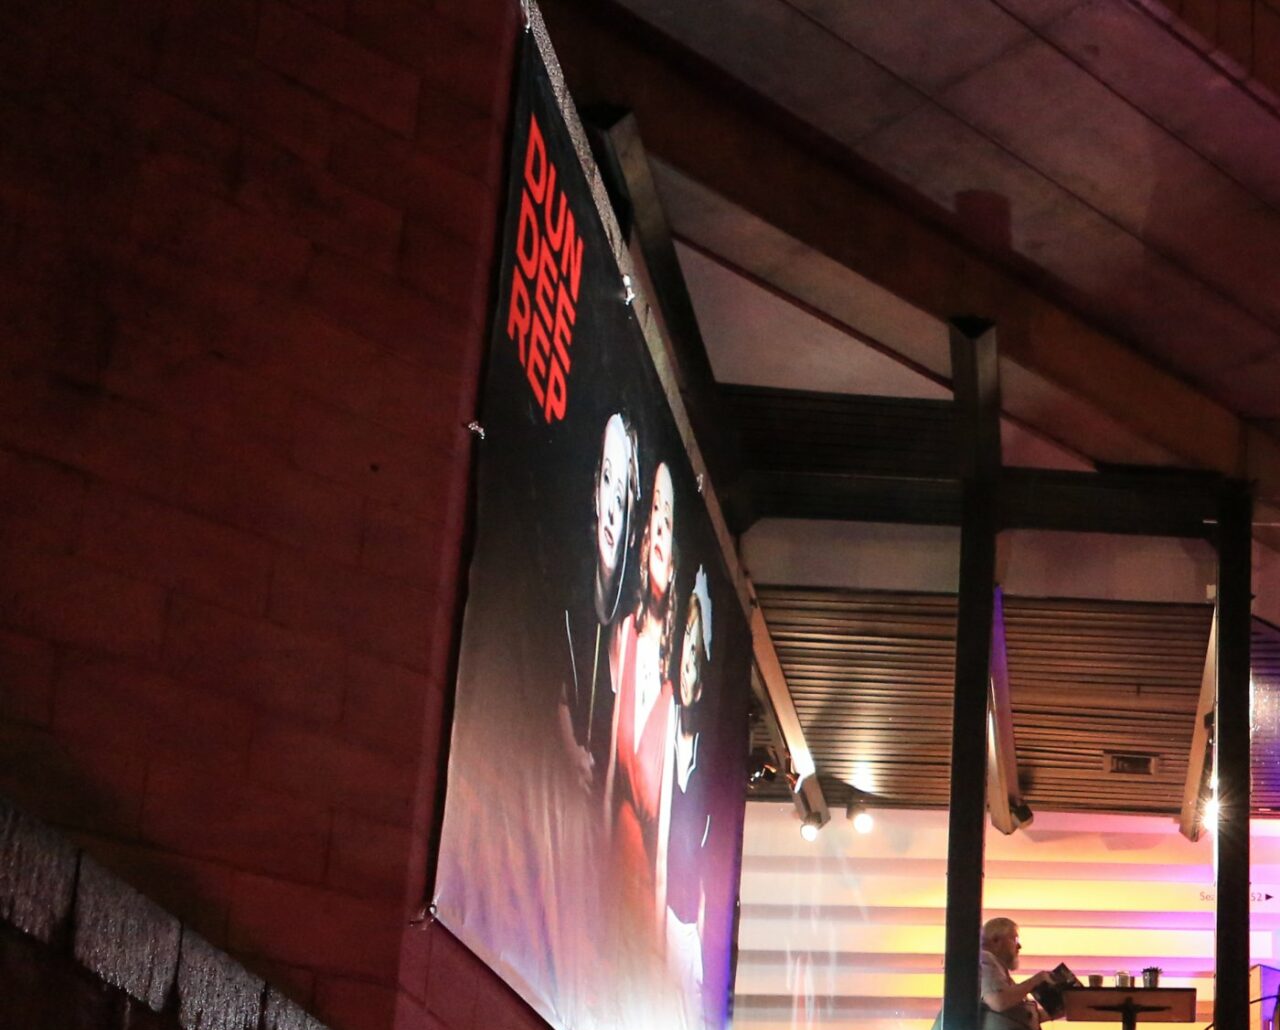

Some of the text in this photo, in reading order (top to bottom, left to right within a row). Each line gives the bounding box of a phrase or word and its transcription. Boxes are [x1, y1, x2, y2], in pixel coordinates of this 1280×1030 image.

[516, 188, 576, 373] DEE
[524, 112, 583, 303] DUN
[507, 265, 567, 424] REP
